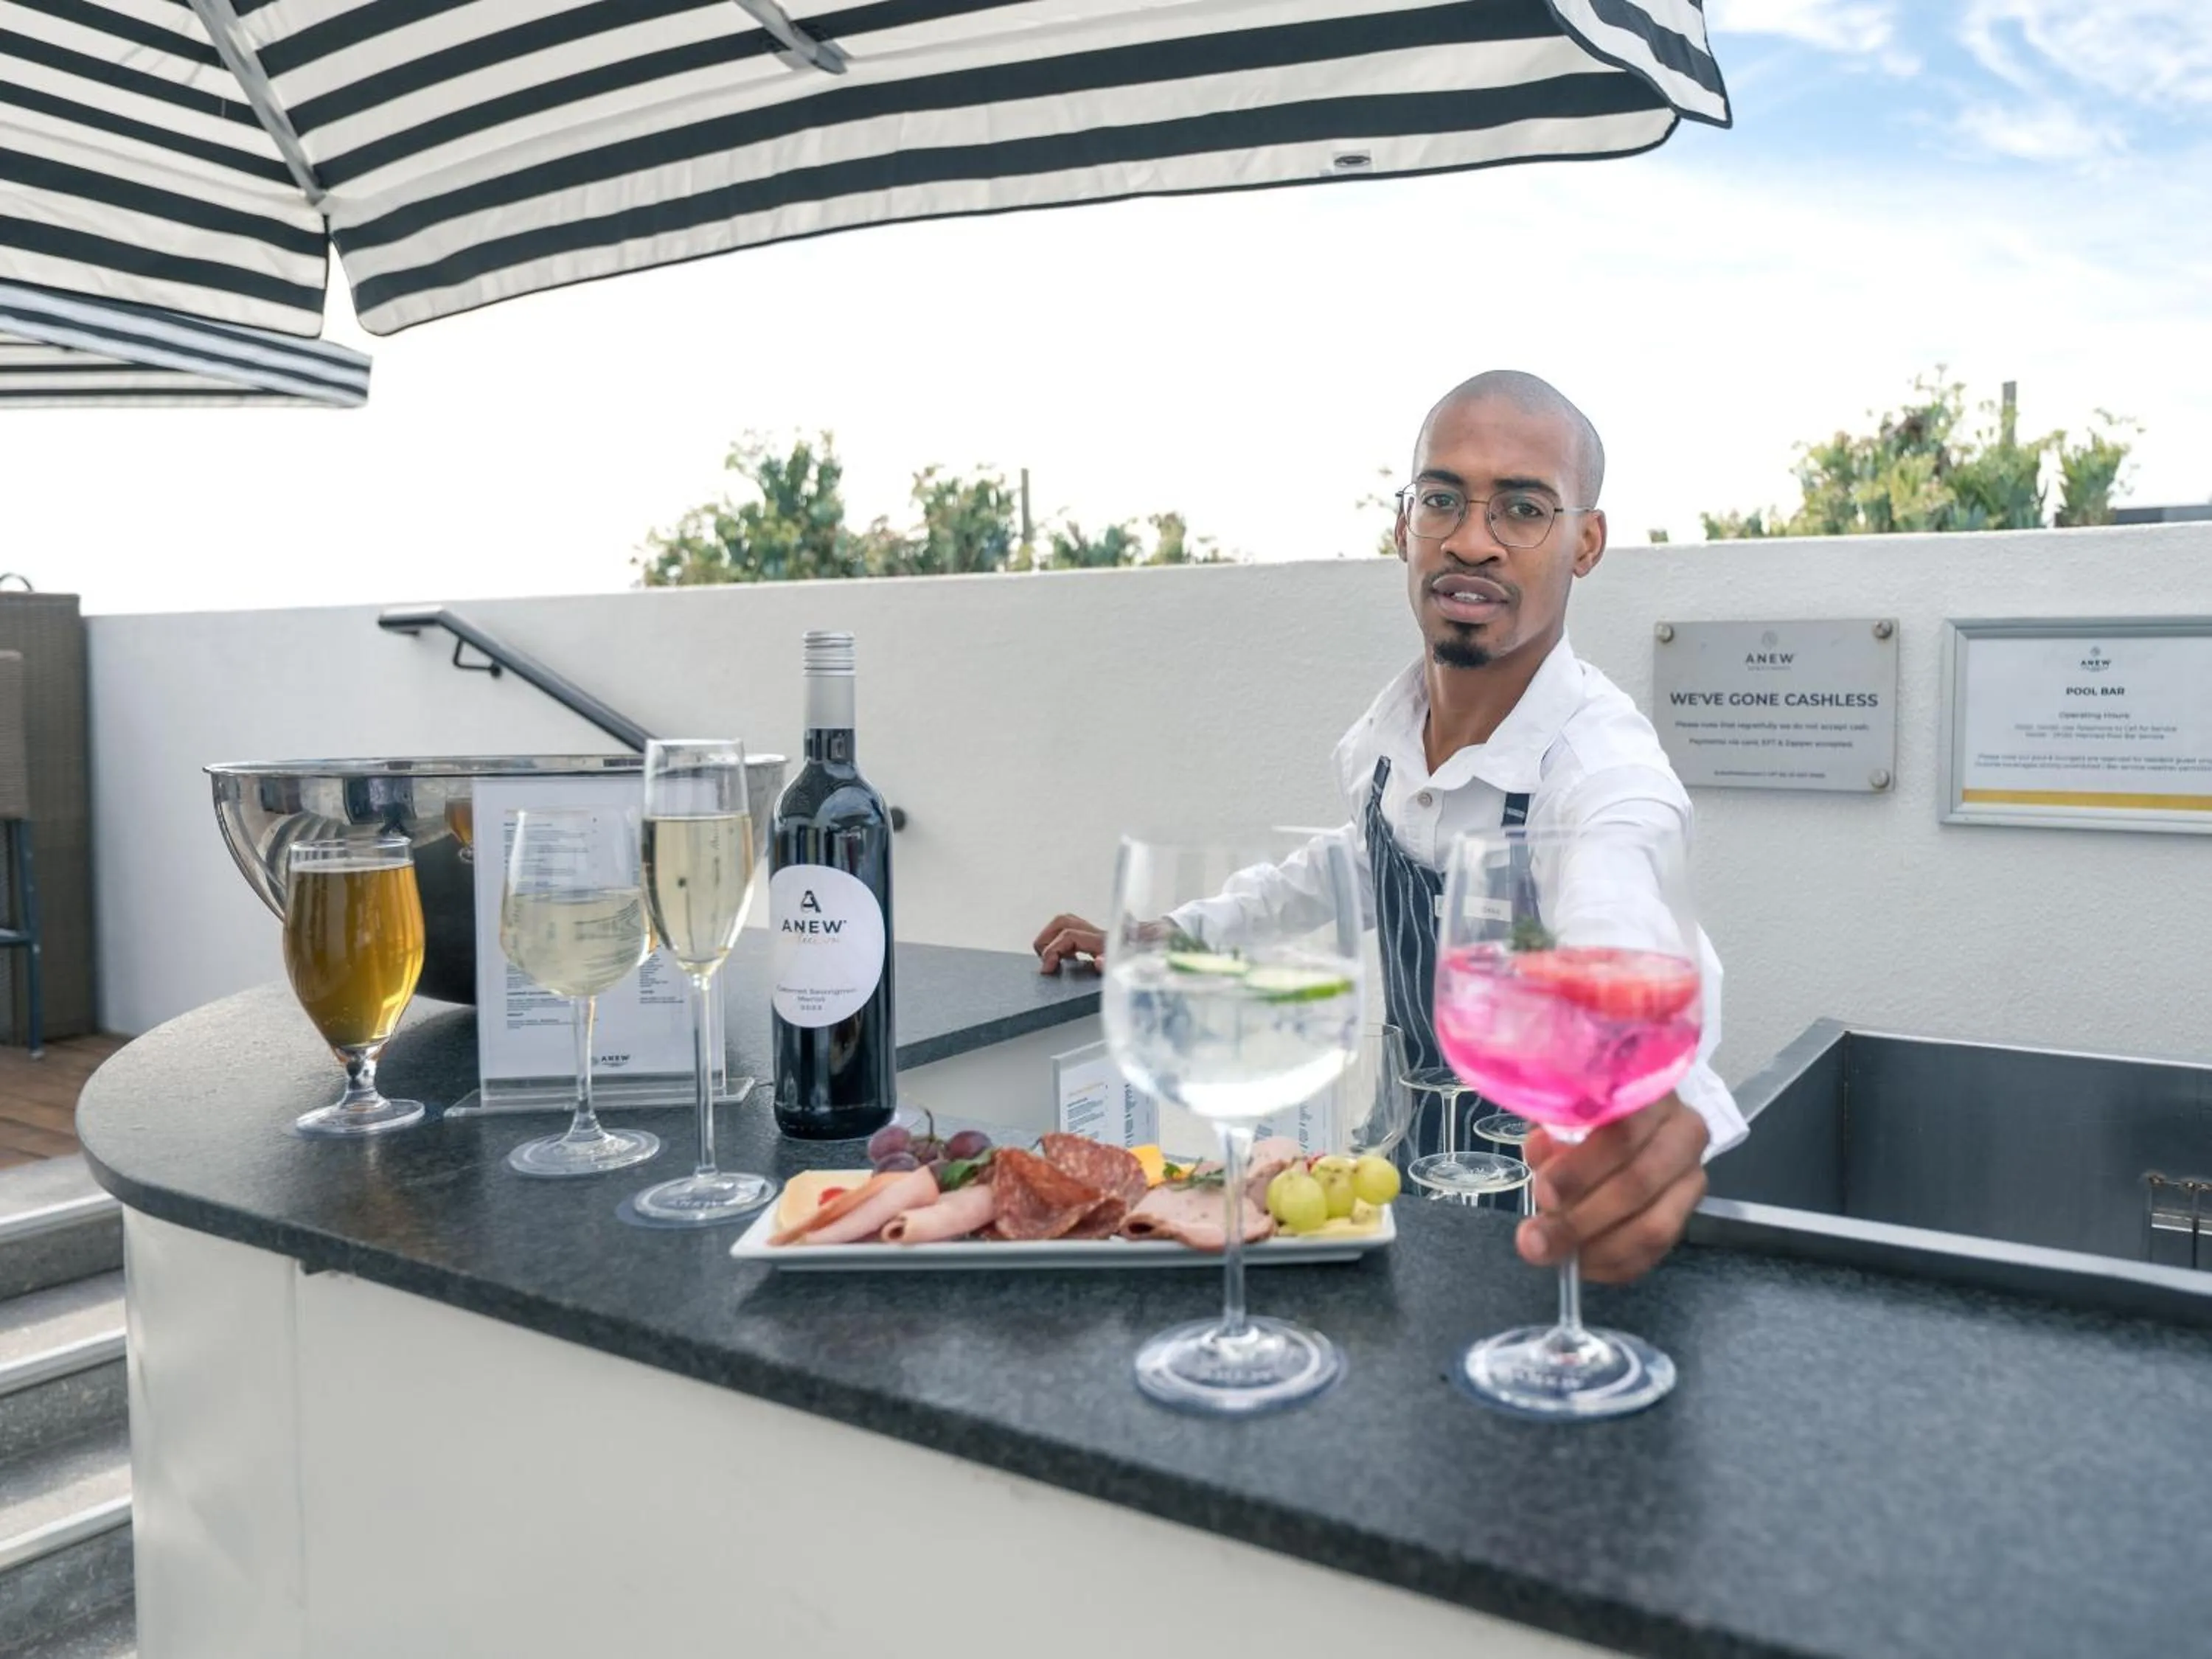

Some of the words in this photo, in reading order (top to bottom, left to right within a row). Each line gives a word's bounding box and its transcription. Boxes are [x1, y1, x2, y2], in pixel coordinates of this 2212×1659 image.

[1745, 653, 1795, 664] ANEW
[2066, 686, 2098, 696] POOL
[2101, 686, 2125, 696] BAR
[1670, 692, 1724, 706] WE'VE
[1729, 693, 1779, 706] GONE
[1784, 694, 1879, 706] CASHLESS
[782, 919, 843, 933] ANEW
